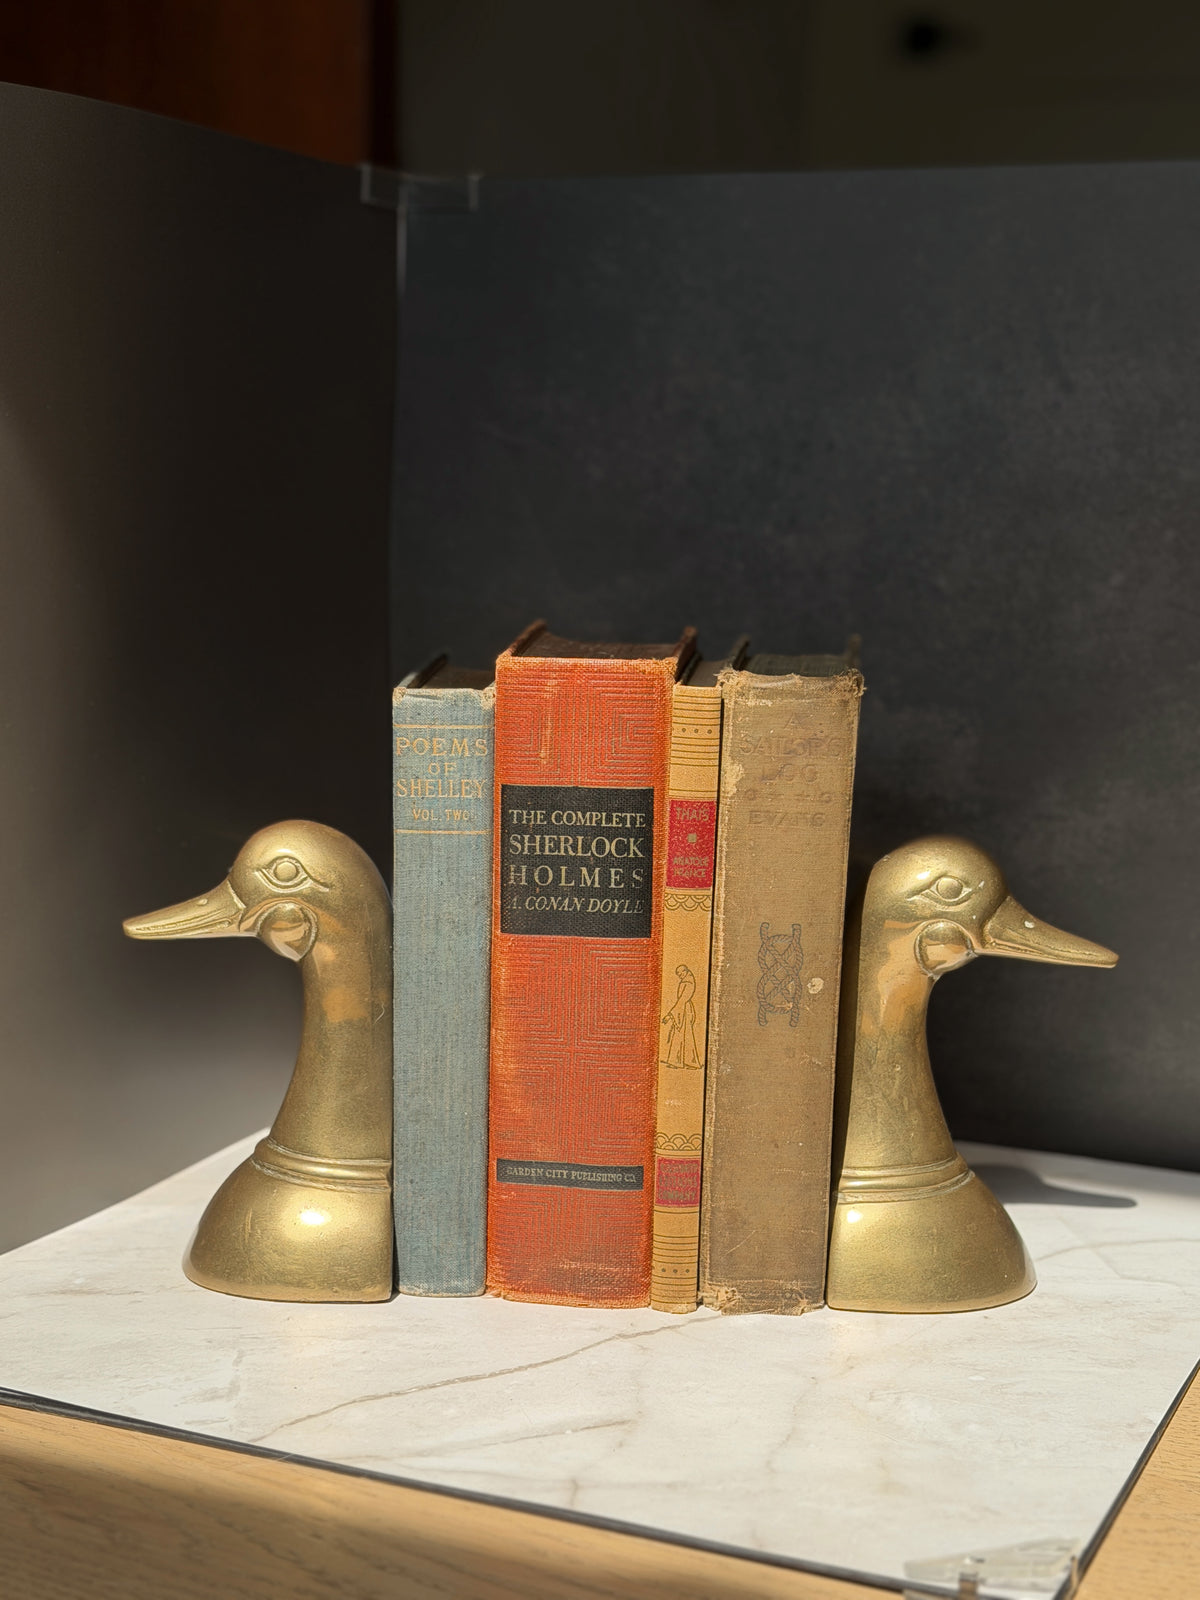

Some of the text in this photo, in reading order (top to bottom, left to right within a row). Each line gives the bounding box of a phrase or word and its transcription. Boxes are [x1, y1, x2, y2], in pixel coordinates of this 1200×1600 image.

[395, 736, 489, 757] POEMS
[427, 762, 456, 776] OF
[395, 778, 488, 799] SHELLEY
[508, 809, 646, 828] THE COMPLETE
[509, 833, 646, 858] SHERLOCK
[508, 864, 645, 889] HOLMES
[525, 895, 585, 912] CONAN
[586, 897, 645, 914] DOYLE
[506, 1166, 544, 1177] GARDEN
[545, 1168, 569, 1179] CITY
[571, 1170, 623, 1182] PUBLISHING
